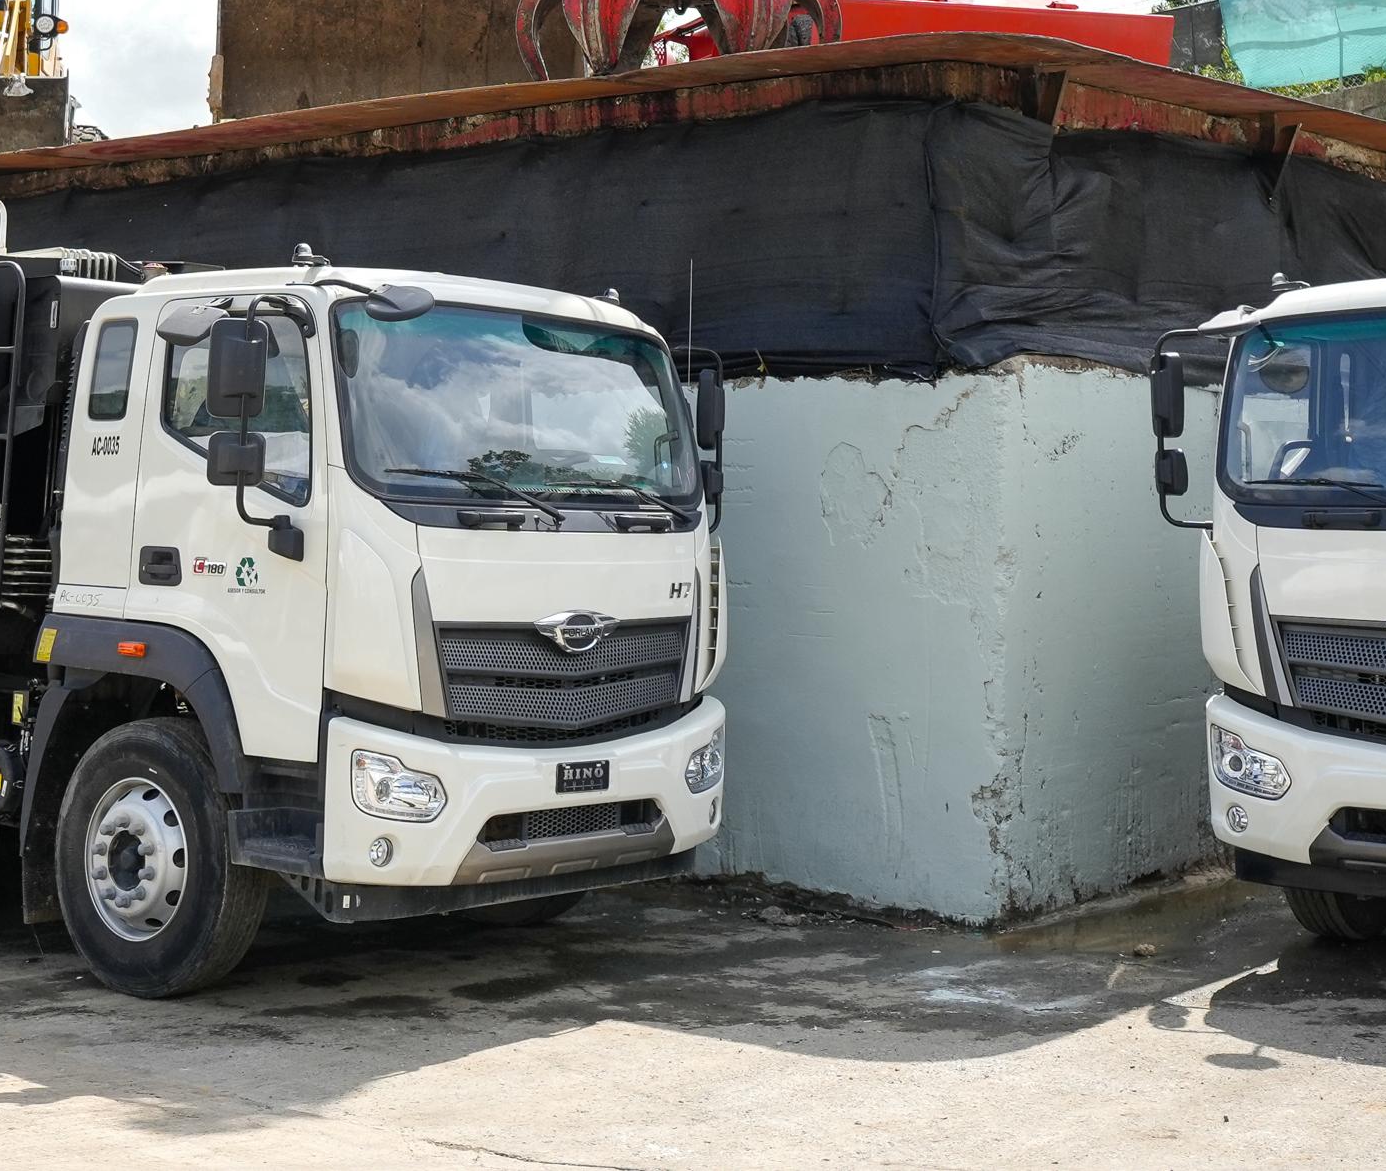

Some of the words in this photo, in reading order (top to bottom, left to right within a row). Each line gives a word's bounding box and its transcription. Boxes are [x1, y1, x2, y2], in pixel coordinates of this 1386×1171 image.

[91, 436, 120, 456] AC-0035
[207, 563, 225, 574] 180
[669, 582, 692, 599] H7
[563, 767, 604, 780] HINO
